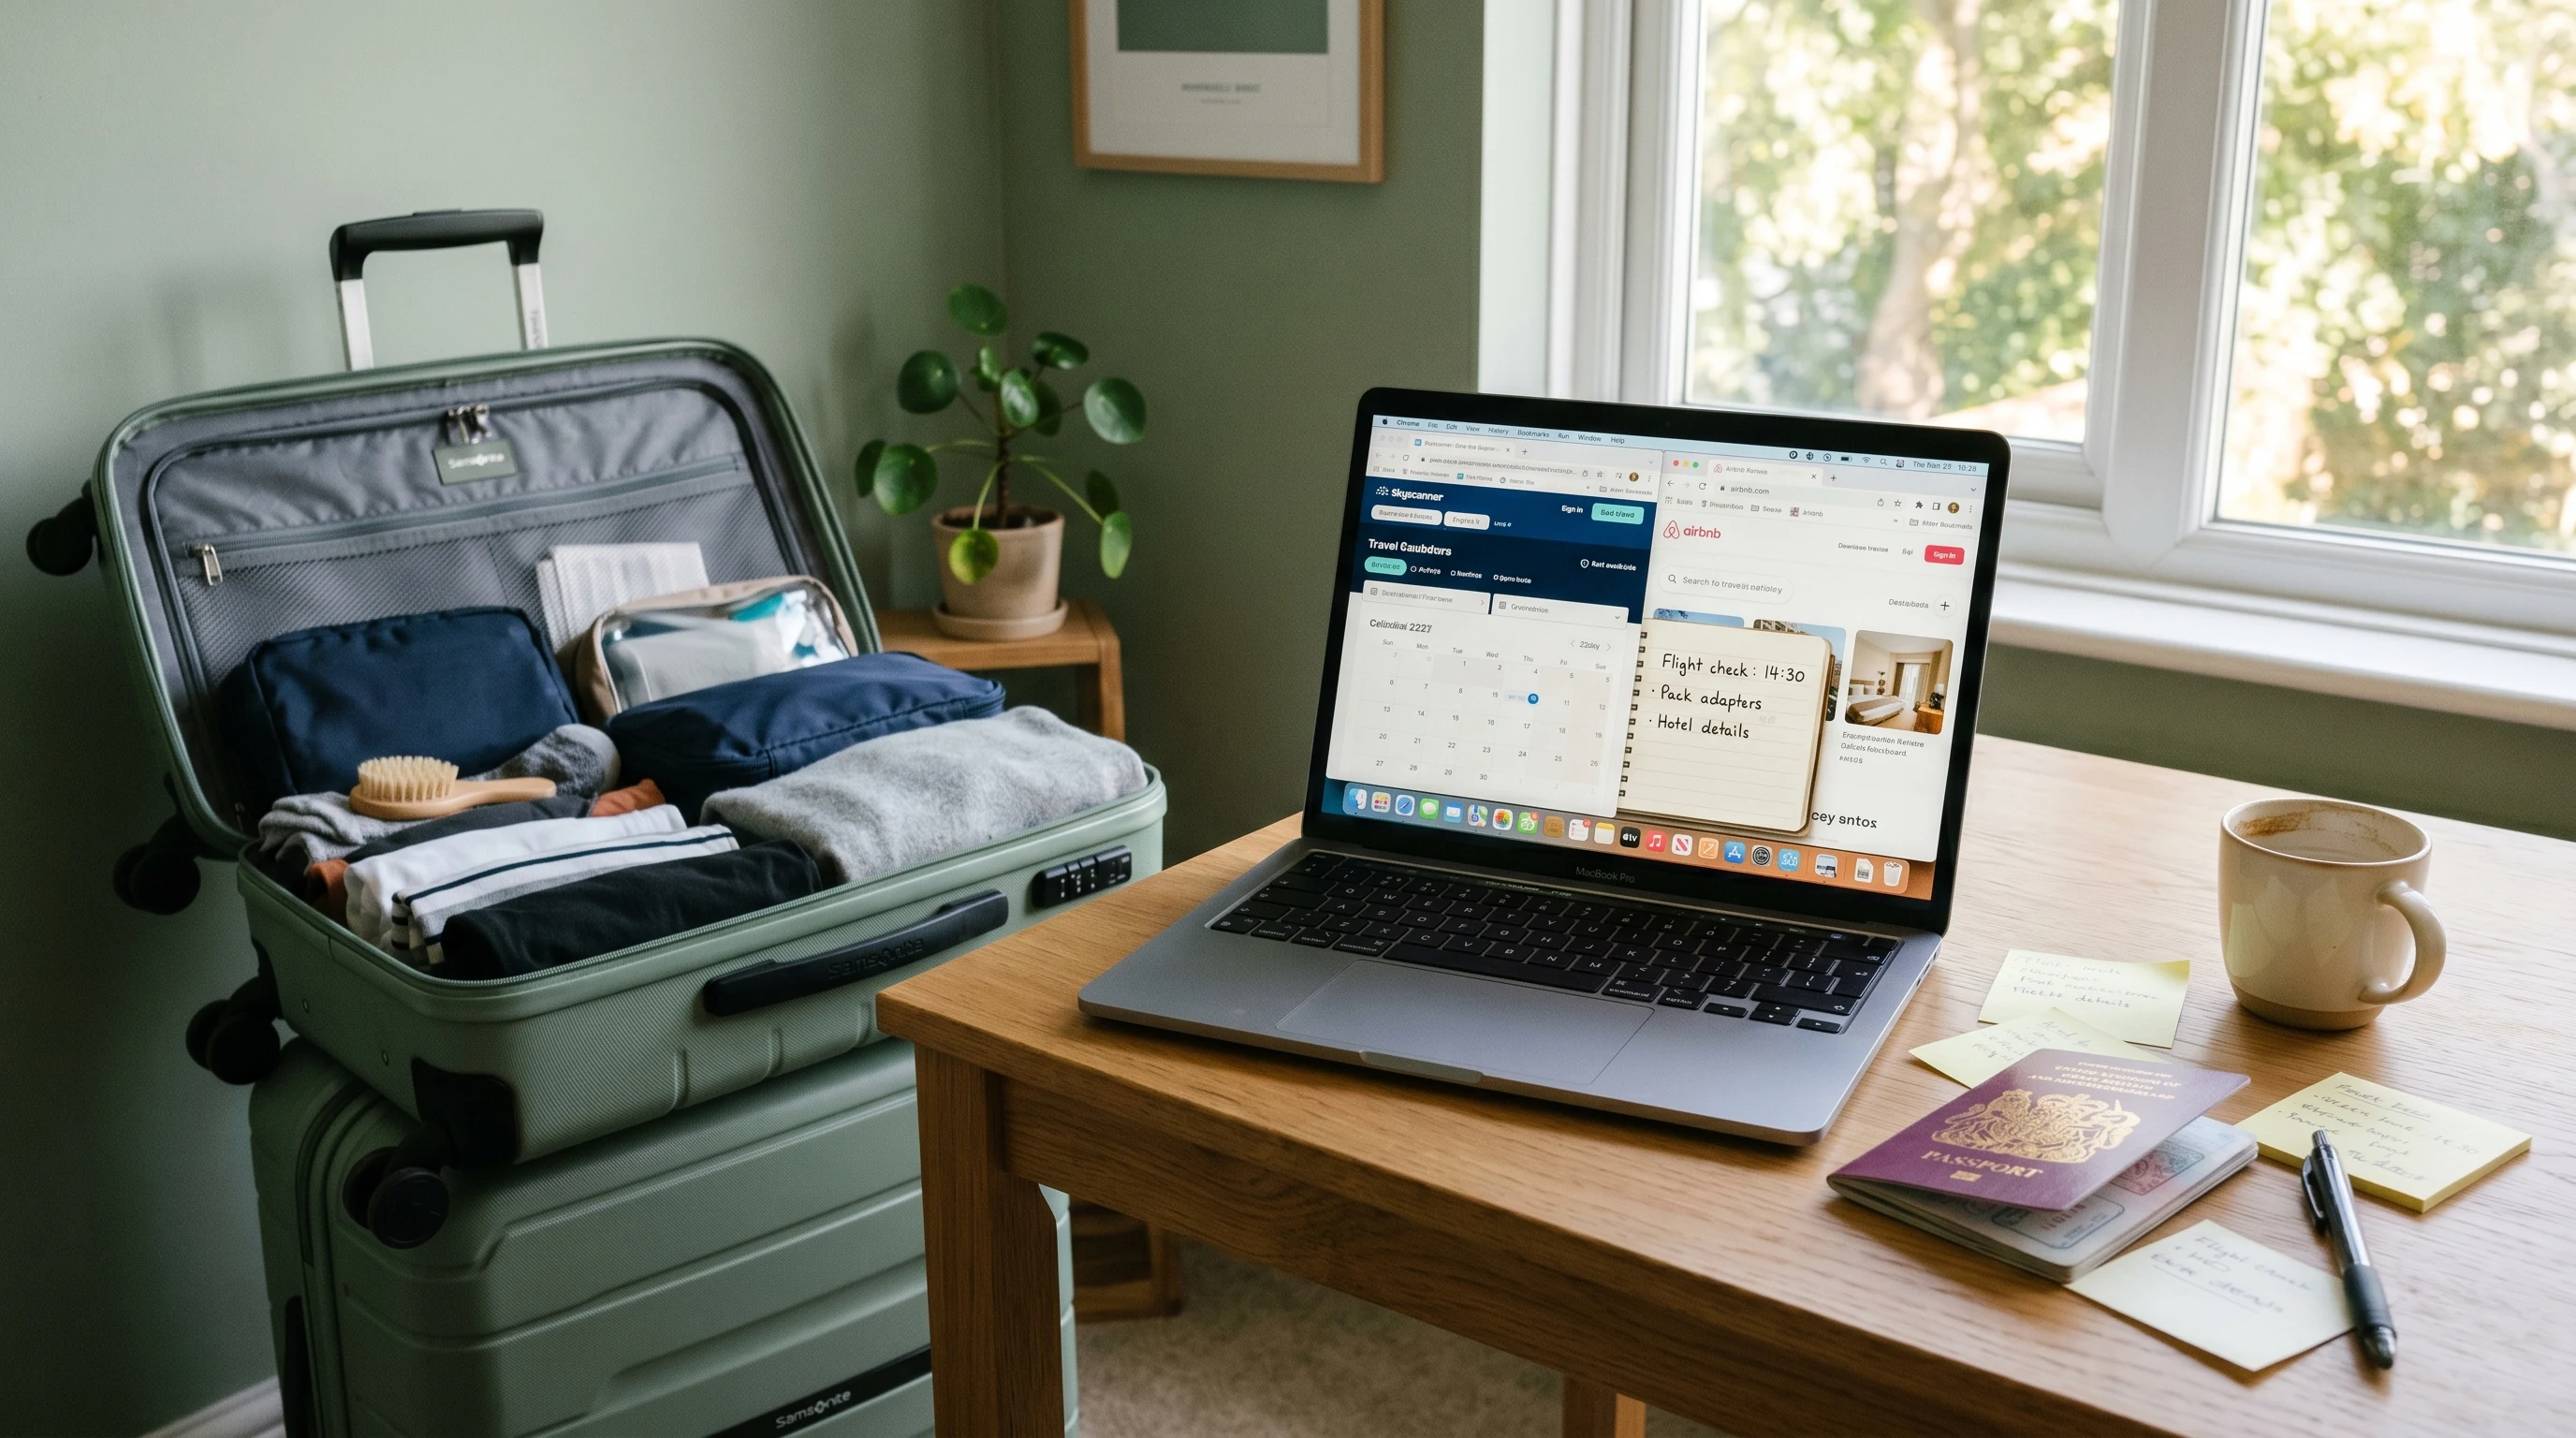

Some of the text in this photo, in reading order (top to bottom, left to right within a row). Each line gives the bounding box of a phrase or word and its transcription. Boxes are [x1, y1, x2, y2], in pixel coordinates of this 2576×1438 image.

[1391, 488, 1444, 502] Skyscanner
[1730, 486, 1770, 495] airbnb.com
[1683, 525, 1721, 539] airbnb
[1368, 538, 1399, 550] Travel
[1682, 577, 1710, 587] Search
[1662, 653, 1704, 677] Flight
[1709, 660, 1749, 678] check
[1764, 665, 1805, 682] 14:30
[1661, 683, 1763, 713] Pack adapters
[1657, 713, 1692, 732] Hotel
[1701, 719, 1750, 740] details
[1810, 812, 1836, 826] cey
[1575, 866, 1635, 883] MacBook Pro
[1921, 1150, 2044, 1179] PASSPORT
[775, 1390, 852, 1430] Samsonite
